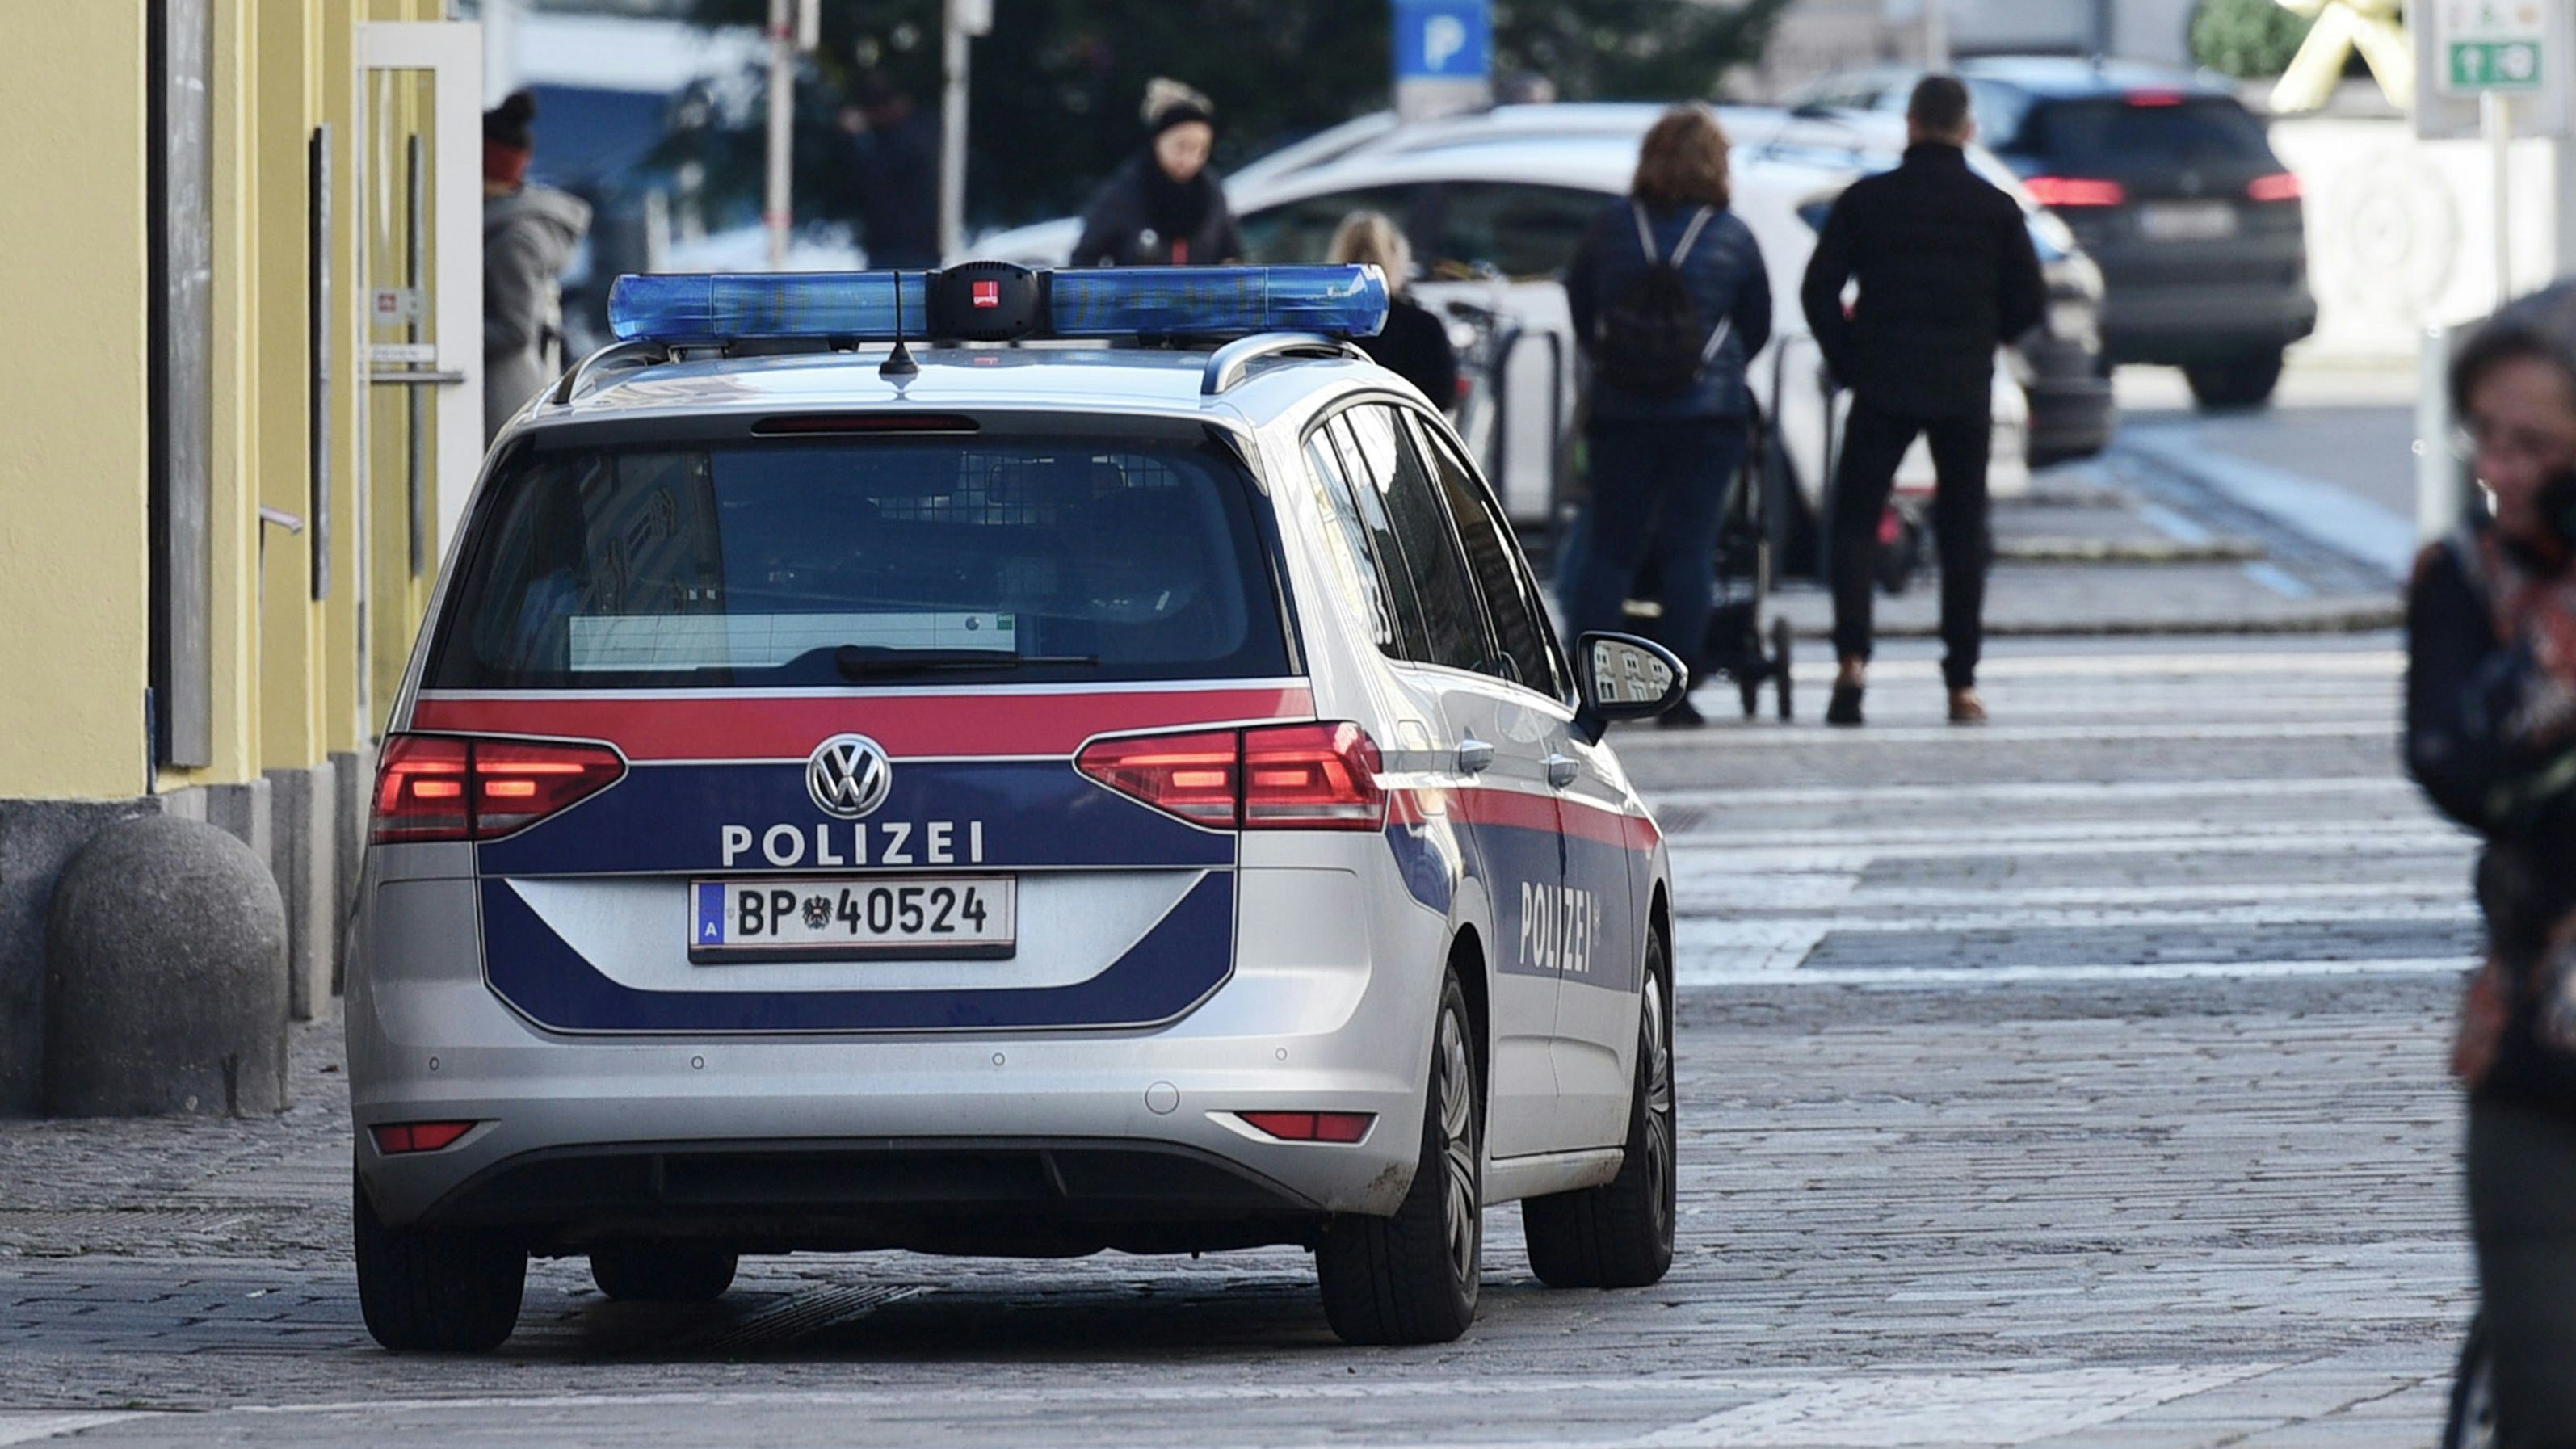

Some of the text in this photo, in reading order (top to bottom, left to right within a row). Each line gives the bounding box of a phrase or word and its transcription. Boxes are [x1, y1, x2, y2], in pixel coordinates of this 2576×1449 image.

[1422, 15, 1466, 71] P
[810, 737, 887, 814] VW
[721, 821, 983, 867] POLIZEI
[704, 921, 718, 937] A
[738, 886, 987, 936] BP 40524
[1519, 881, 1591, 973] POLIZEI
